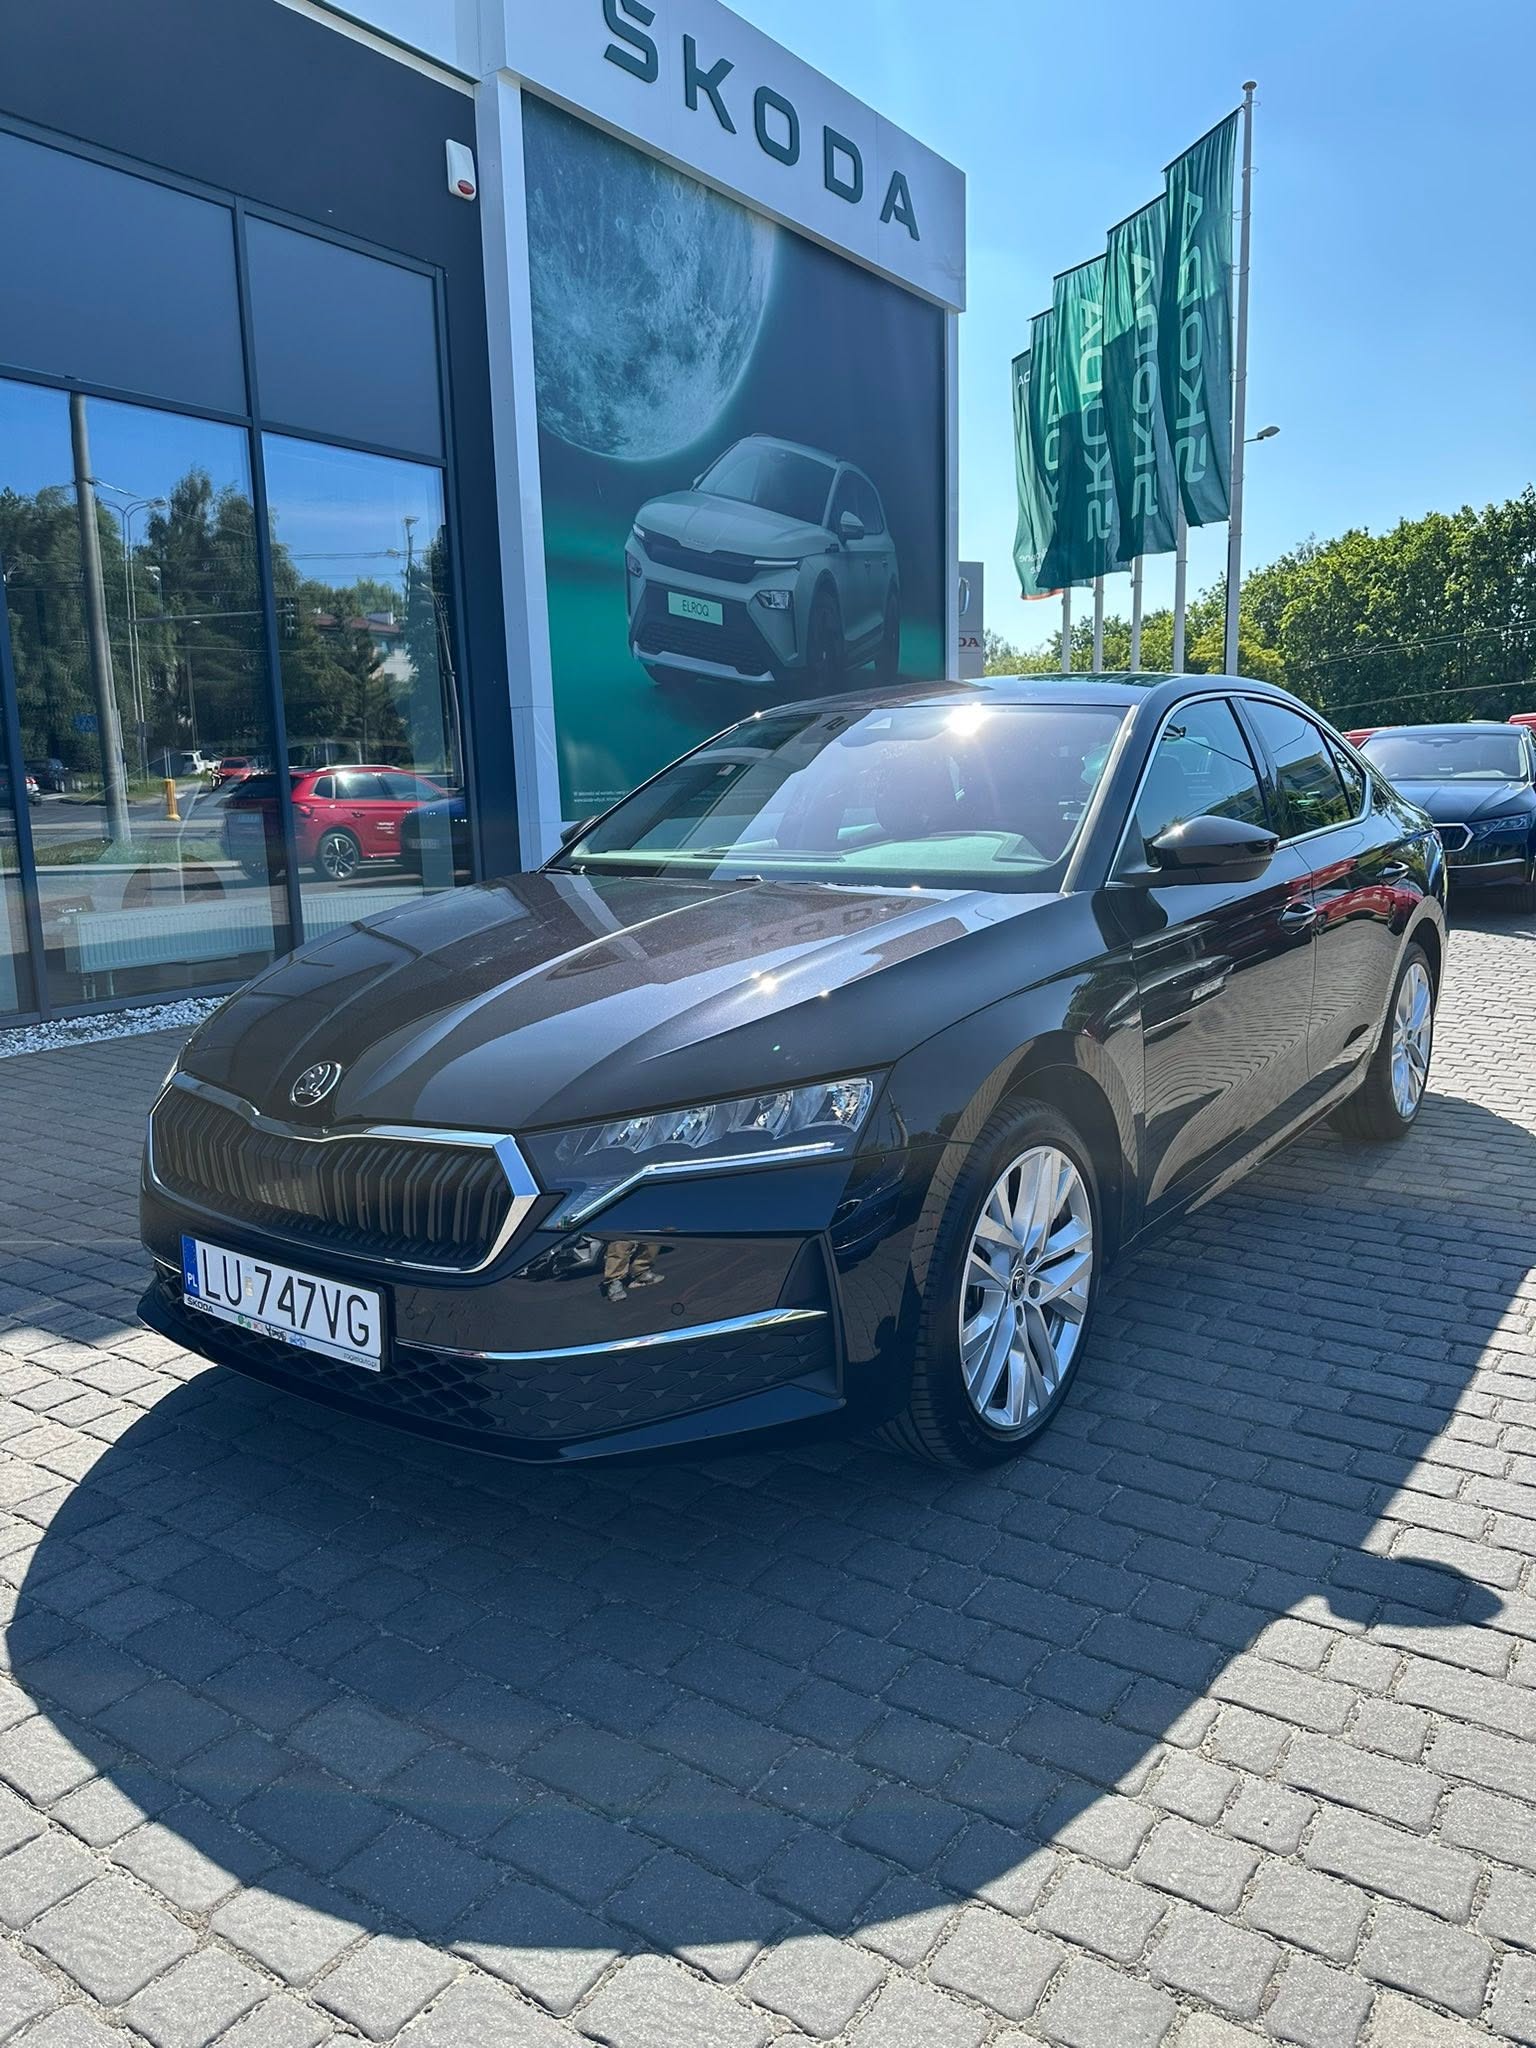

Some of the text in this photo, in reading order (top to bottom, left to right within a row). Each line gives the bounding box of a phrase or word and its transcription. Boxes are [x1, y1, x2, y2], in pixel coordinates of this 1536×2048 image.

[682, 599, 710, 617] ELROQ
[187, 1272, 198, 1288] PL
[203, 1248, 370, 1348] LU 747VG
